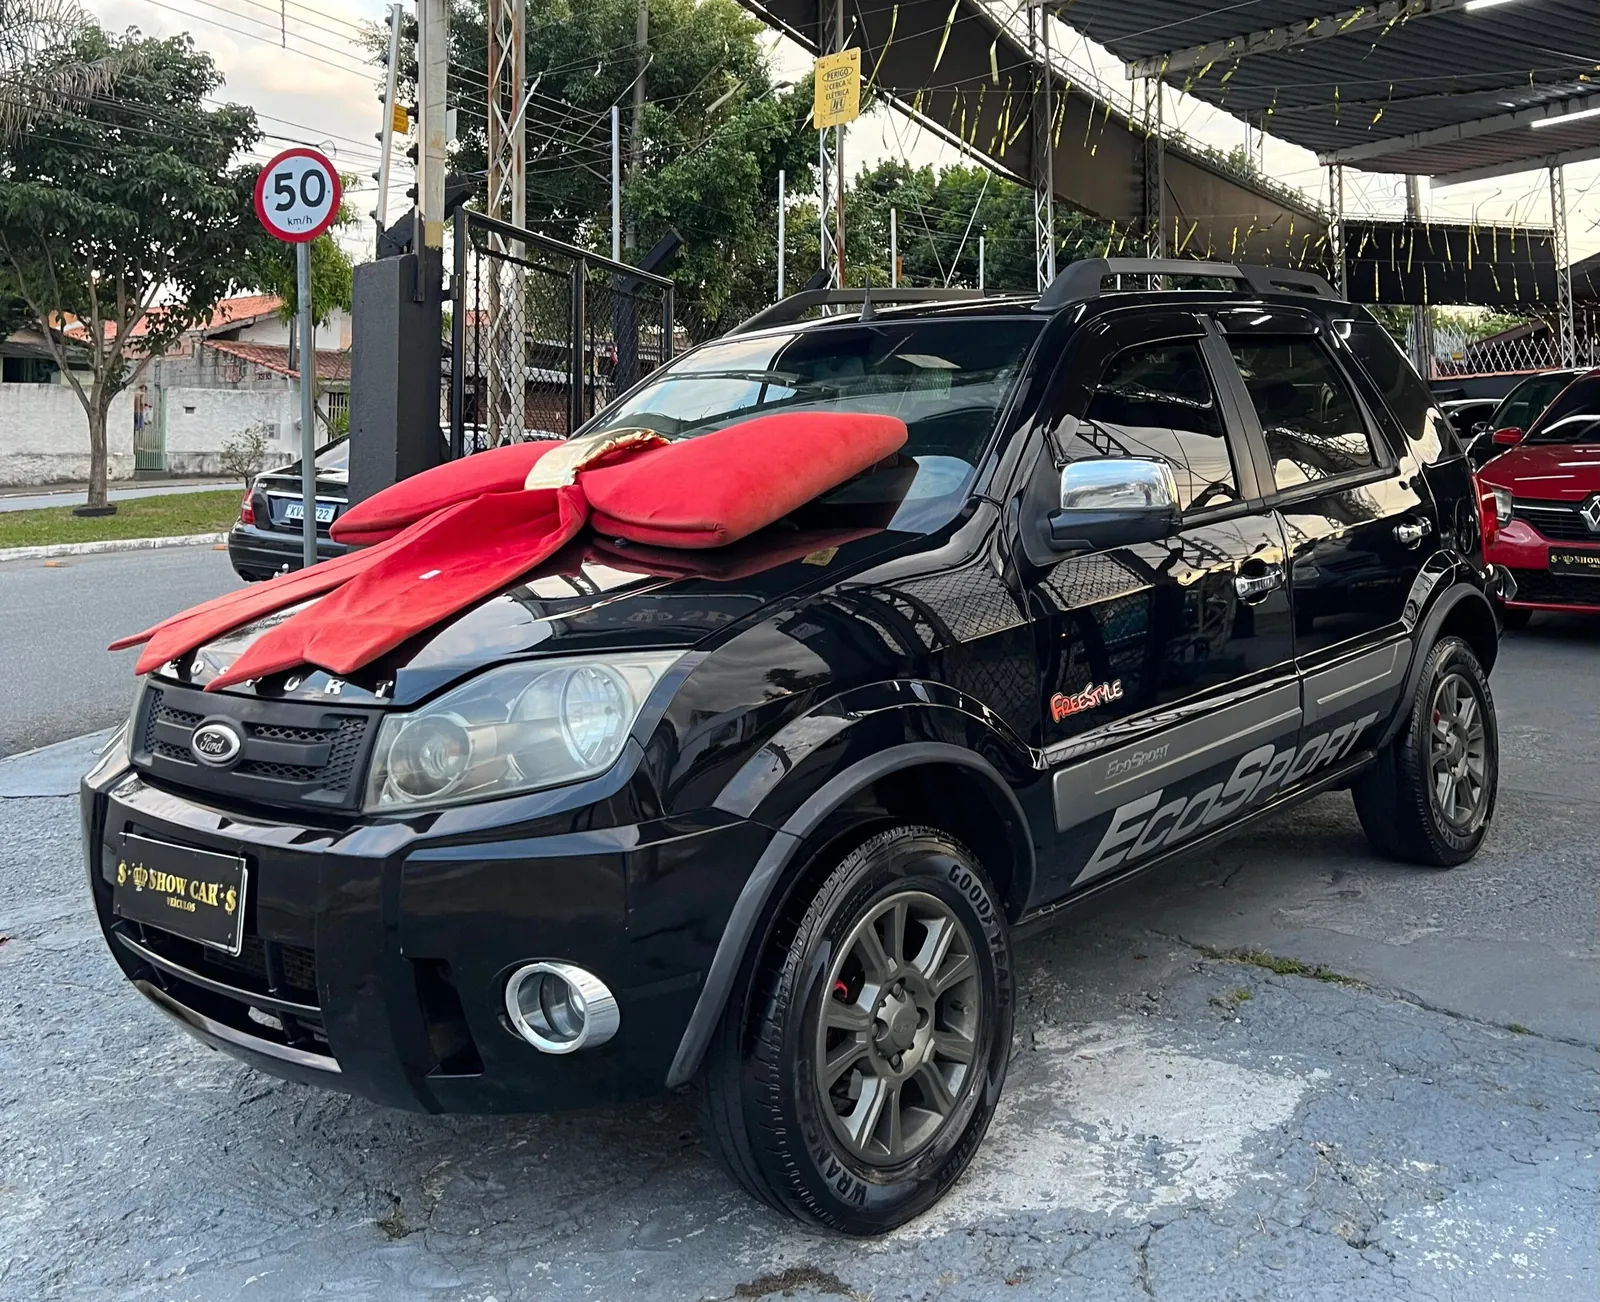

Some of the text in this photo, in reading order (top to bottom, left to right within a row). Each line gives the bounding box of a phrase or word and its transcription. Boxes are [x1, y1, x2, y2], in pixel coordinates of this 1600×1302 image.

[826, 68, 849, 80] PERIGO
[829, 80, 846, 90] CERCA
[274, 168, 326, 212] 50
[287, 215, 312, 226] km/h
[1050, 679, 1123, 723] FREESTYLE
[200, 732, 225, 754] Ford
[148, 868, 188, 896] SHOW
[189, 880, 219, 907] CAR
[166, 896, 196, 913] VEÍCULOS
